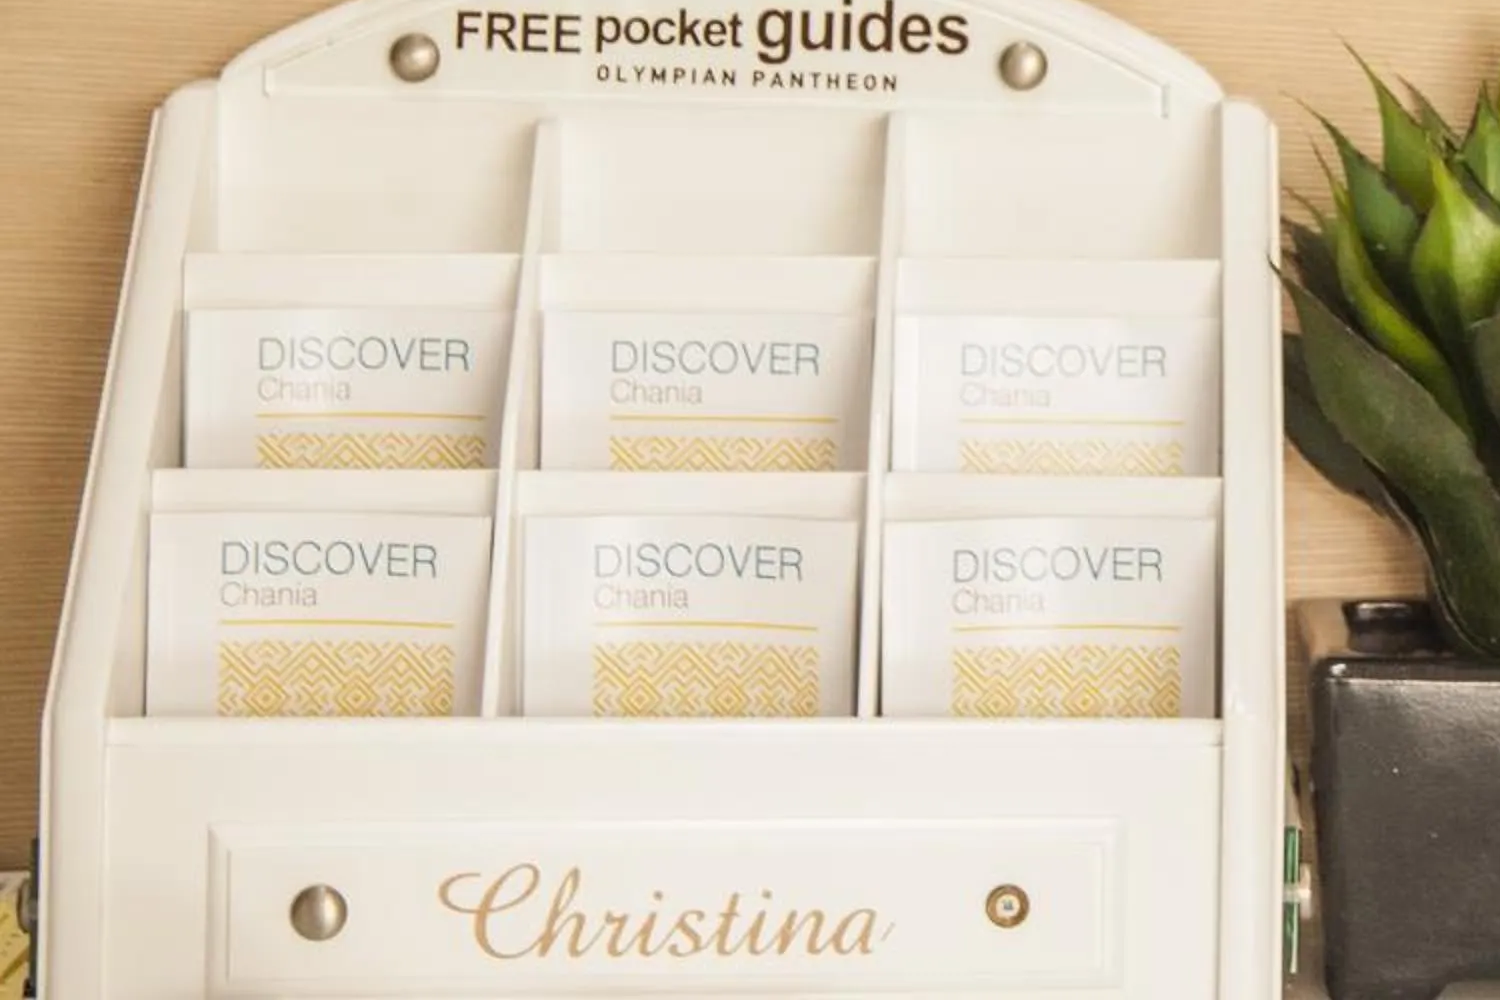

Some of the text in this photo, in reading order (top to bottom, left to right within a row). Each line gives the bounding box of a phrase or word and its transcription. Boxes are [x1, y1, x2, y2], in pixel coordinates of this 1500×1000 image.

[456, 11, 582, 53] FREE
[595, 8, 744, 54] pocket
[596, 65, 899, 92] OLYMPIAN PANTHEON
[258, 336, 470, 372] DISCOVER
[611, 340, 820, 376] DISCOVER
[960, 343, 1167, 378] DISCOVER
[257, 377, 351, 402] Chania
[610, 379, 702, 405] Chania
[960, 382, 1051, 408] Chania
[220, 541, 438, 578] DISCOVER
[594, 543, 803, 581] DISCOVER
[953, 547, 1163, 583] DISCOVER
[220, 582, 318, 607] Chania
[593, 583, 688, 610] Chania
[952, 588, 1045, 614] Chania
[438, 862, 895, 960] Christina
